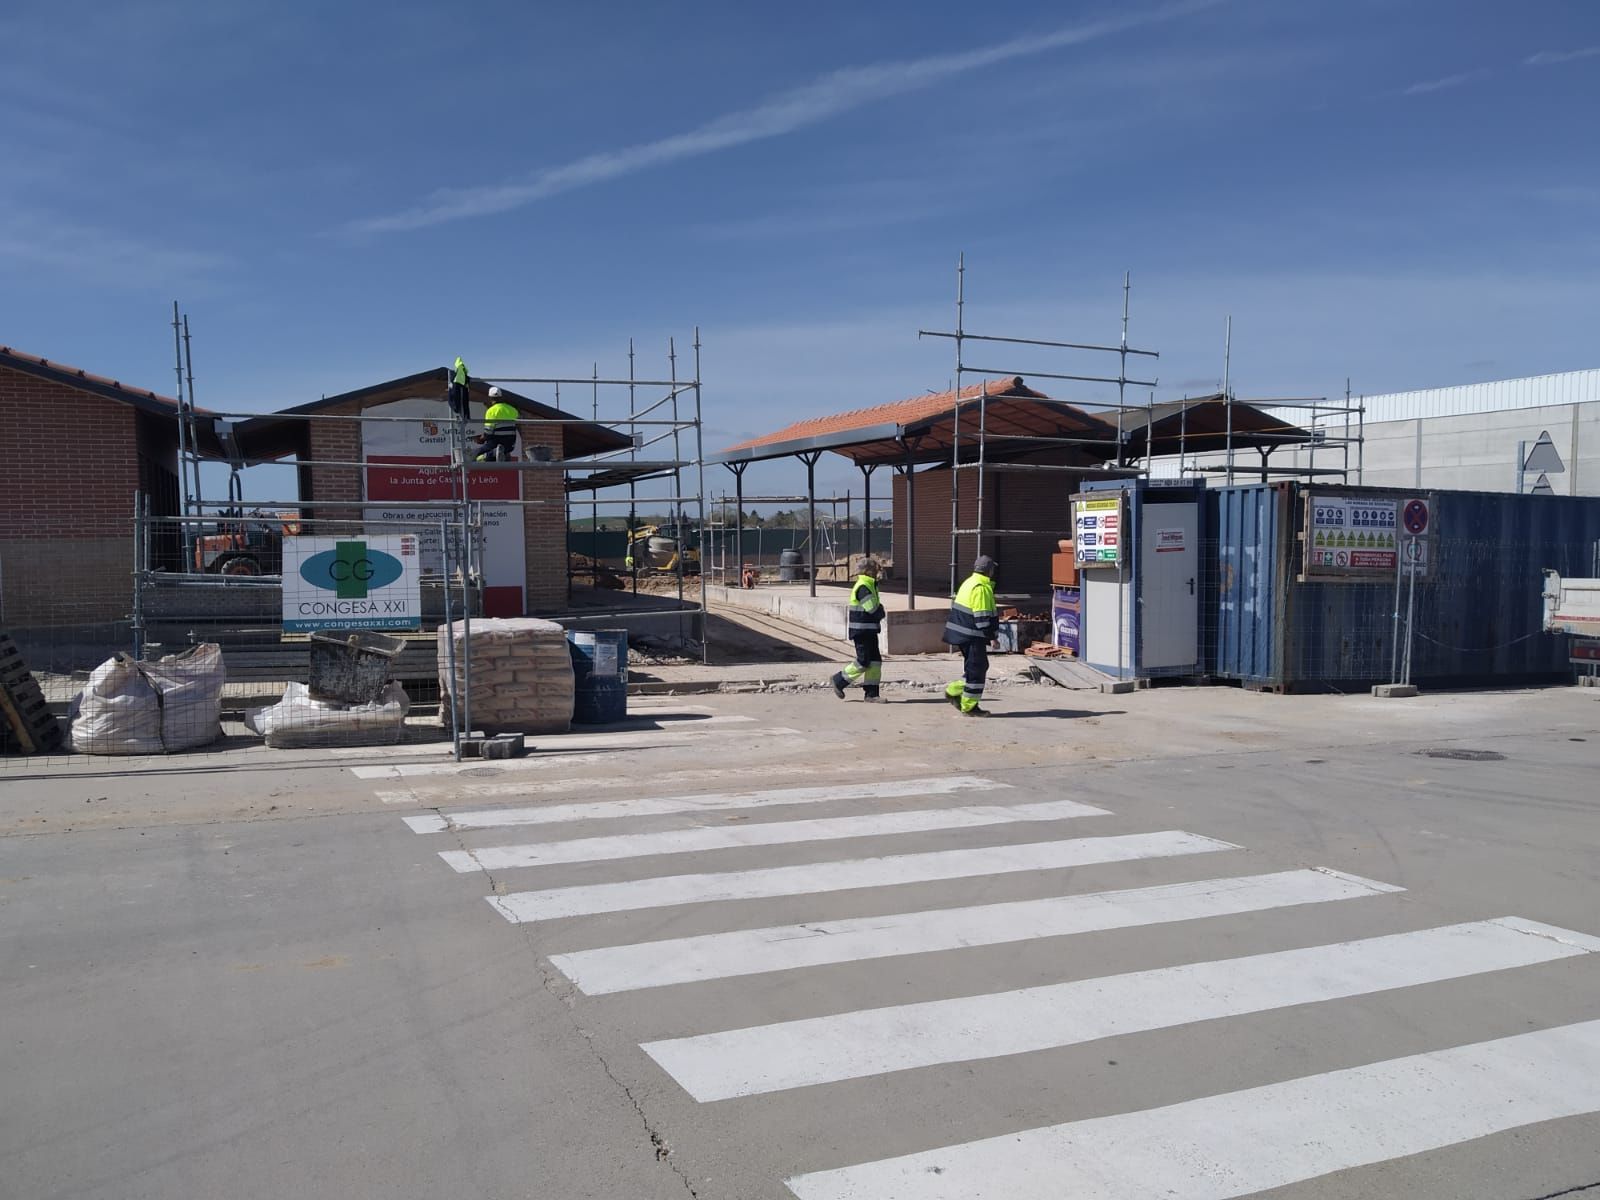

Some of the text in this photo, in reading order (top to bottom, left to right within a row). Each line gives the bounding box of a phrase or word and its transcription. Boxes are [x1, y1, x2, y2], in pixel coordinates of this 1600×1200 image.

[389, 476, 398, 484] la
[400, 476, 424, 485] Junta
[426, 477, 437, 485] de
[438, 475, 469, 484] Casill
[478, 476, 499, 484] León
[328, 559, 375, 582] CG
[299, 601, 406, 615] CONGESA XXI
[295, 619, 412, 630] www.congesaxxi.com
